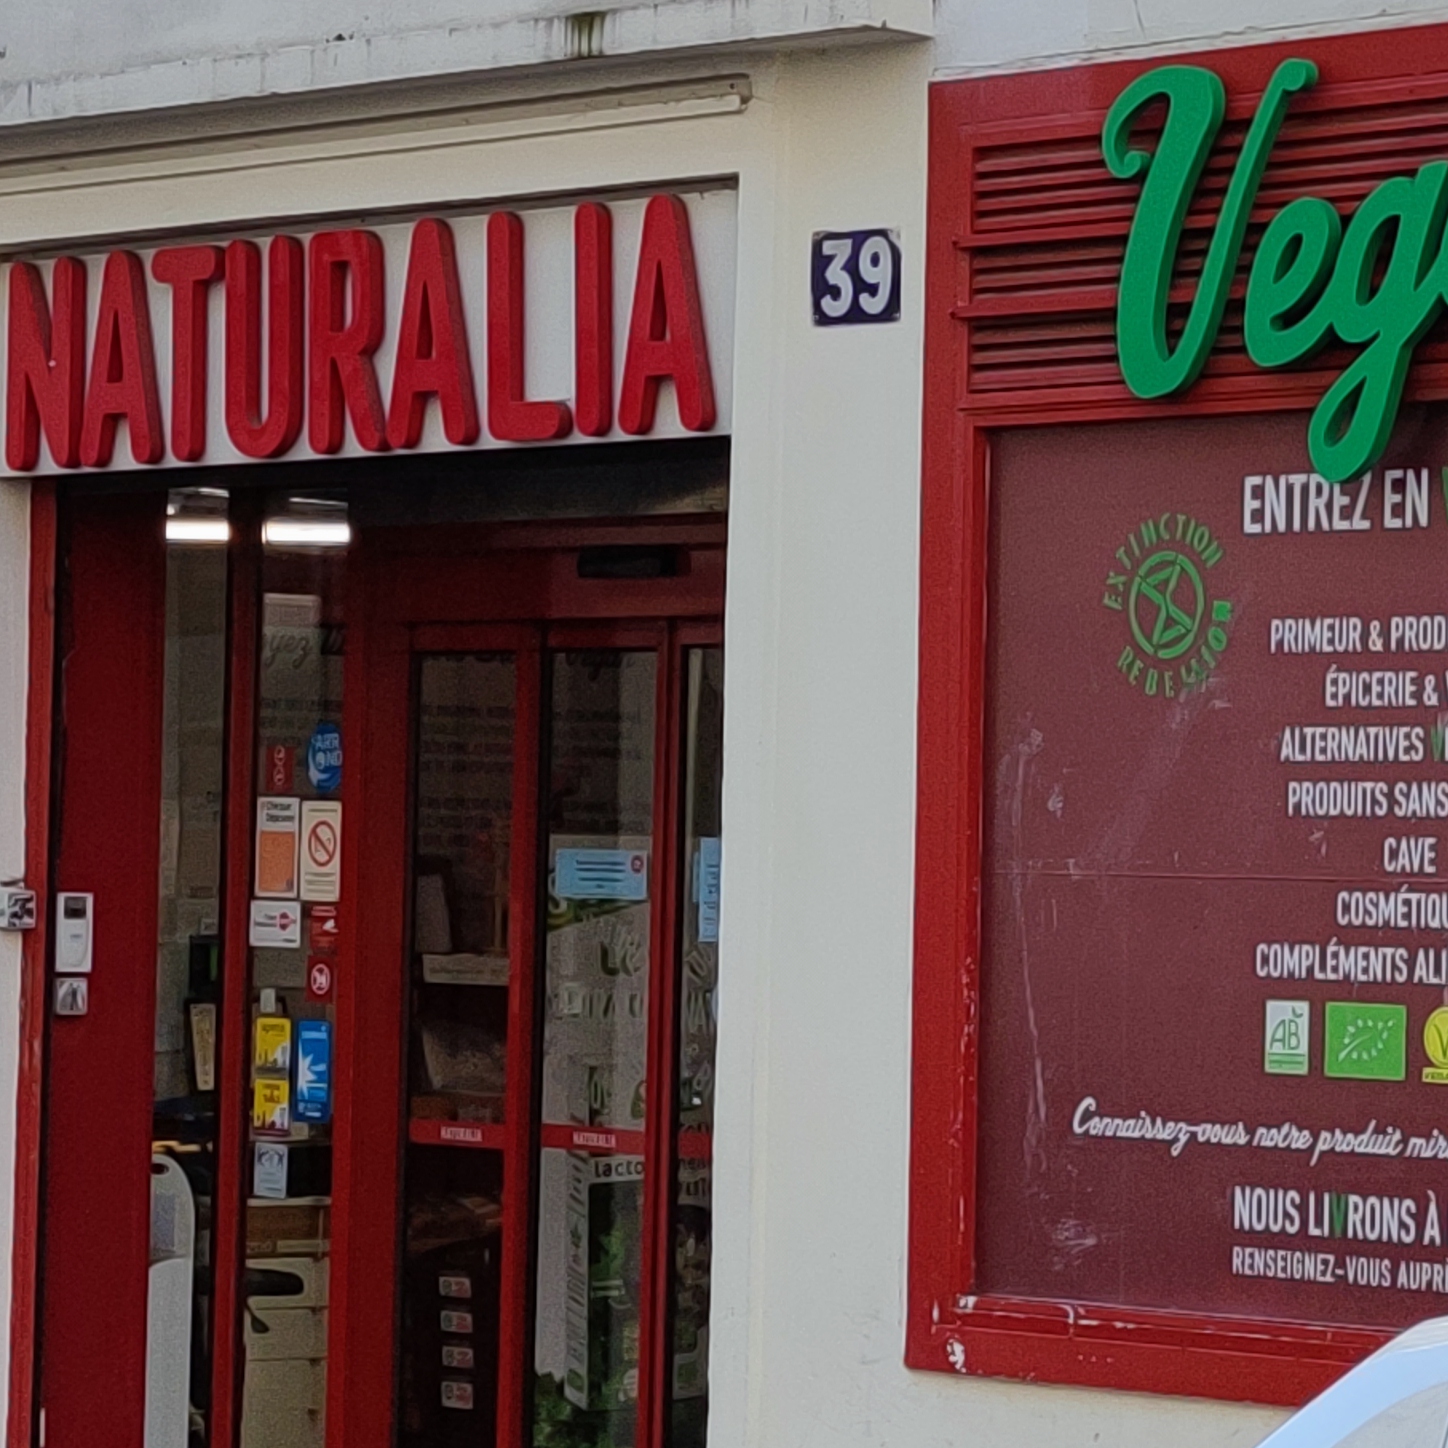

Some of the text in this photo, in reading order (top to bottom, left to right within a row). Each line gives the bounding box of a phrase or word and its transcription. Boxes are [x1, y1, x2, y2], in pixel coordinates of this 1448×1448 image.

[818, 234, 894, 319] 39
[4, 192, 717, 473] NATURALIA
[1242, 469, 1372, 534] ENTREZ
[1383, 466, 1430, 530] EN
[1102, 512, 1224, 612] EXTINCTION
[1269, 617, 1363, 654] PRIMEUR
[1367, 619, 1384, 652] &
[1324, 663, 1419, 708] ÉPICERIE
[1422, 674, 1440, 707] &
[1279, 725, 1426, 763] ALTERNATIVES
[1287, 780, 1389, 818] PRODUITS
[1383, 836, 1438, 874] CAVE
[1255, 936, 1409, 984] COMPLÉMENTS
[1269, 1018, 1301, 1051] AB
[1072, 1095, 1251, 1158] Connaissez-vous
[1252, 1121, 1313, 1150] notre
[1309, 1118, 1405, 1167] produit
[1233, 1184, 1301, 1236] NOUS
[1307, 1190, 1418, 1246] LIVRONS
[1422, 1188, 1442, 1248] À
[1231, 1245, 1392, 1289] RENSEIGNEZ-VOUS
